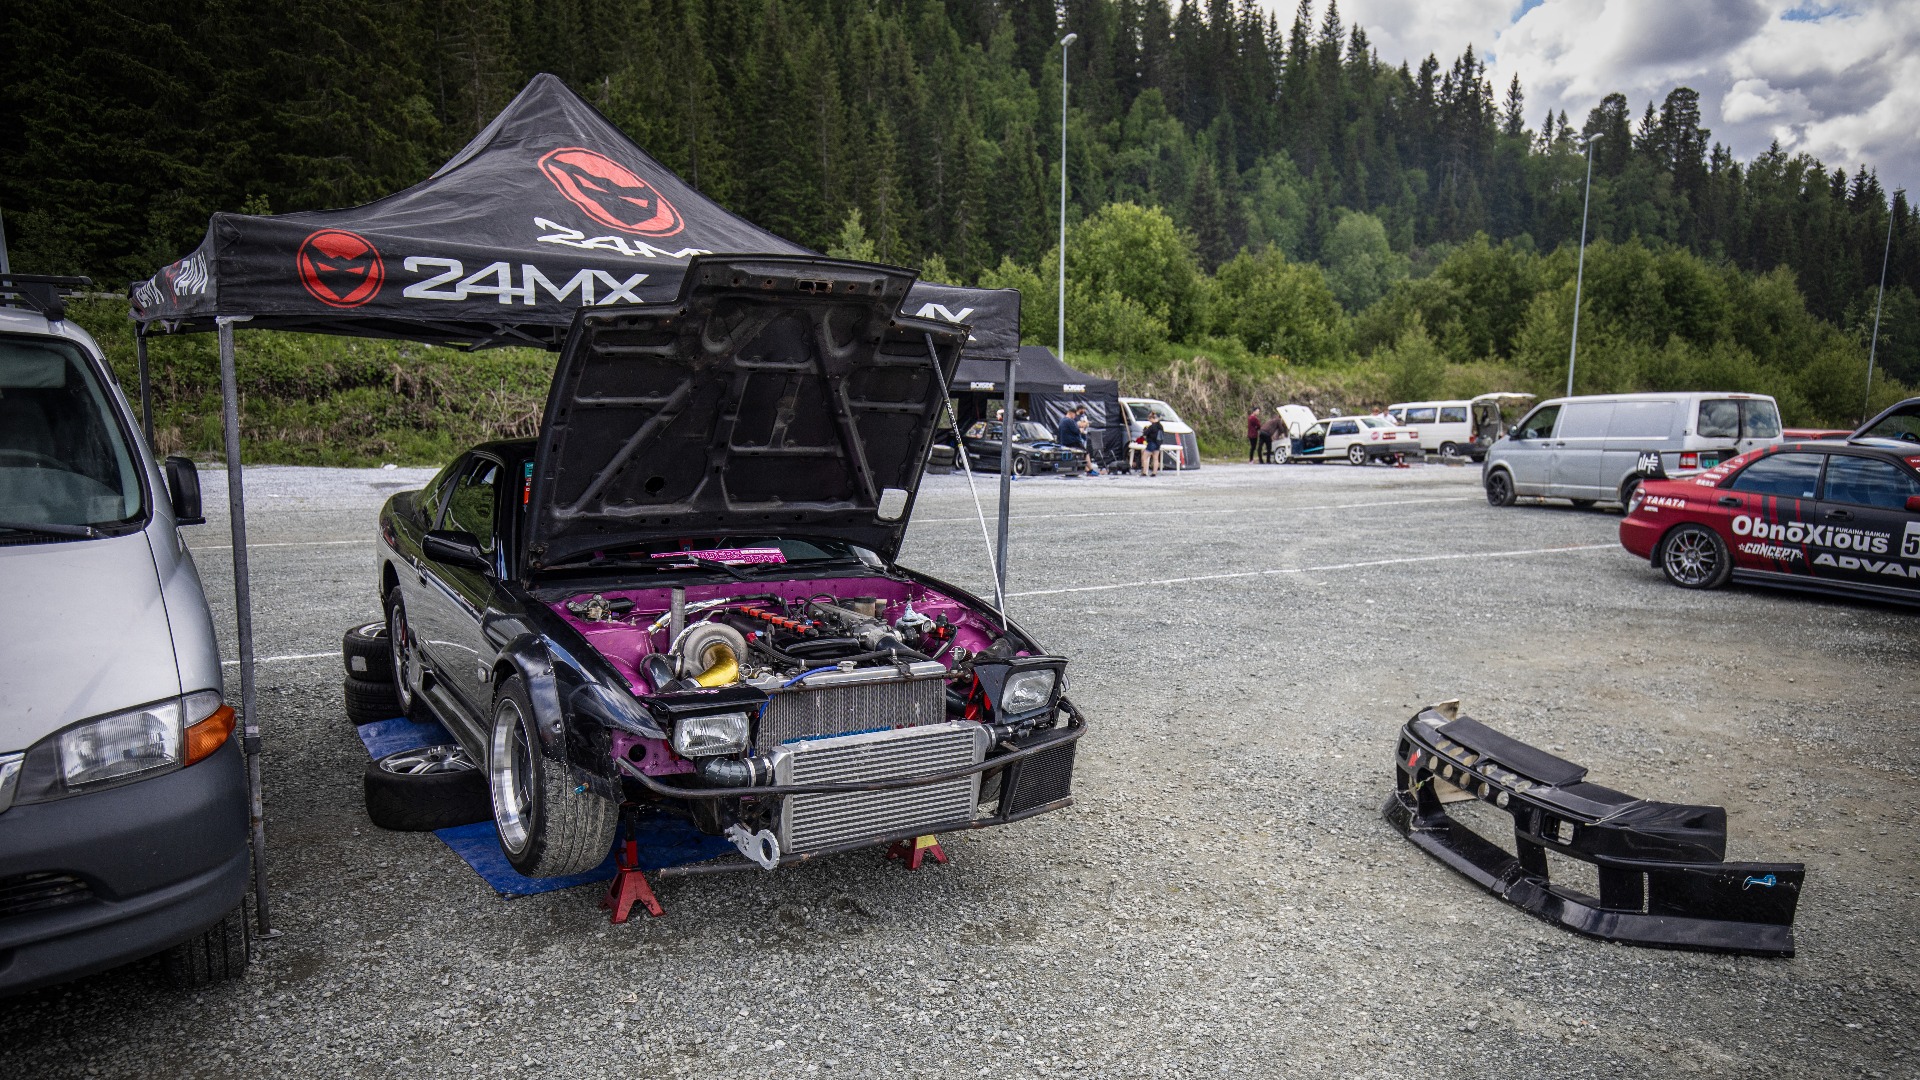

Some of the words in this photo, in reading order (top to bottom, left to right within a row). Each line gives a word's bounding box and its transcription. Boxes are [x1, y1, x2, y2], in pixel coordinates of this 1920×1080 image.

[402, 256, 650, 306] 24MX
[1646, 495, 1686, 509] TAKATA
[1731, 514, 1890, 554] ObnōXious
[1744, 542, 1800, 563] CONCEPT
